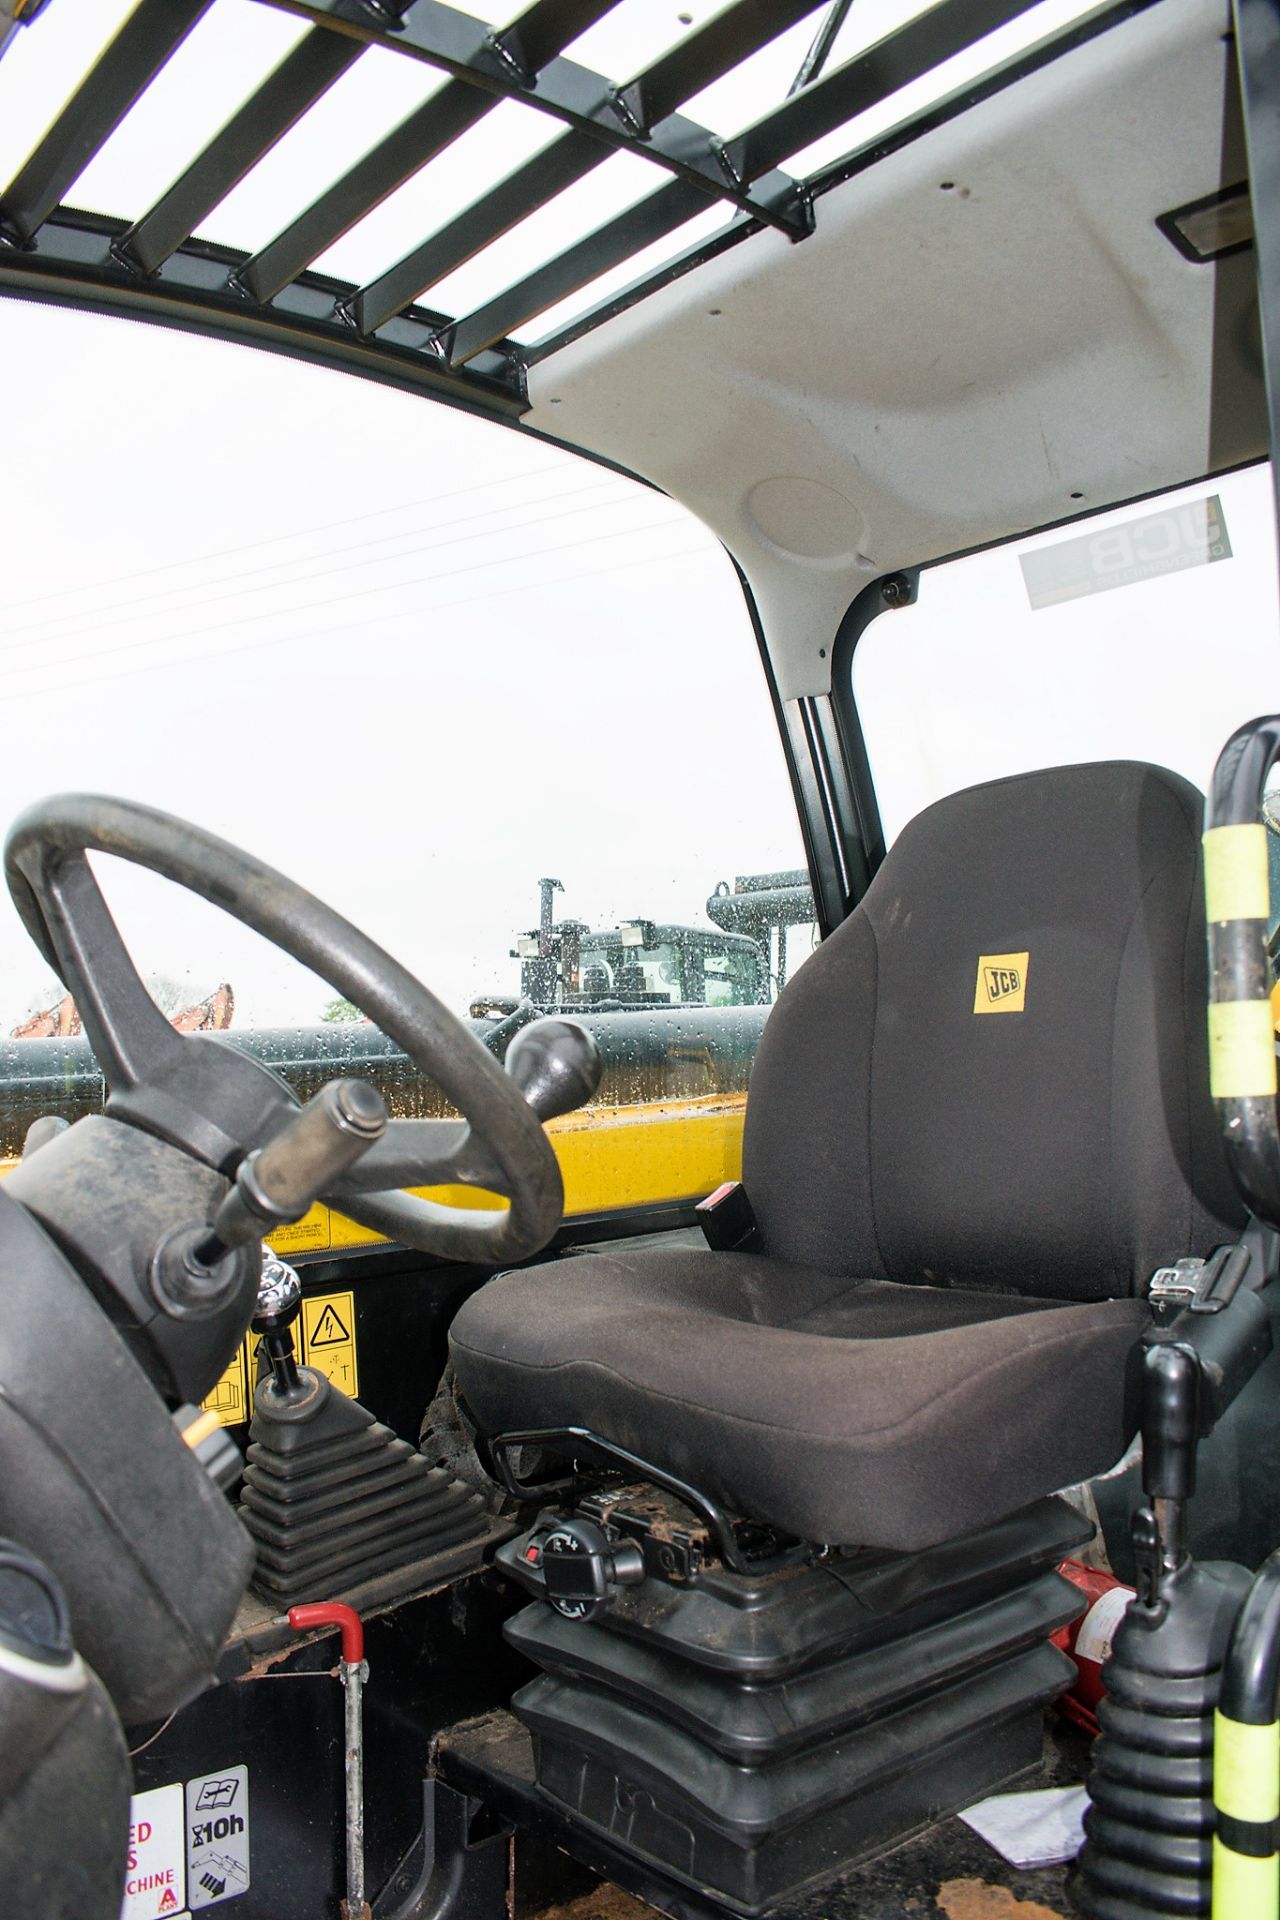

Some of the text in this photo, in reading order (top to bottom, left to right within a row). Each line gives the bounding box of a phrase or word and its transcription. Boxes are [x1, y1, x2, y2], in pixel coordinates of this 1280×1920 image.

[990, 971, 1018, 998] JCB
[128, 1822, 152, 1846] ED
[203, 1814, 244, 1843] 10h
[126, 1849, 138, 1872] S
[126, 1869, 174, 1896] CHINE
